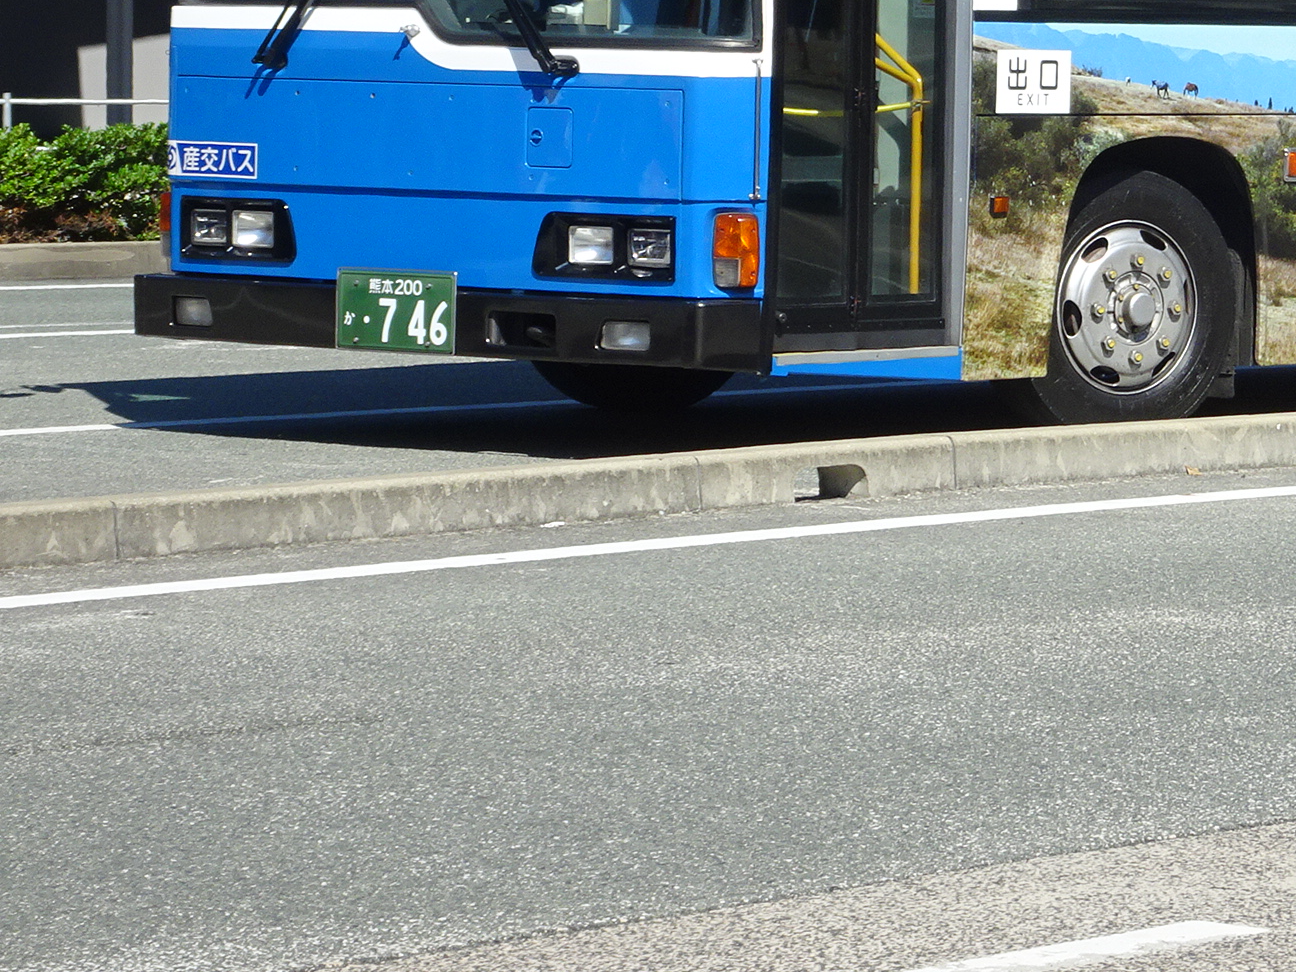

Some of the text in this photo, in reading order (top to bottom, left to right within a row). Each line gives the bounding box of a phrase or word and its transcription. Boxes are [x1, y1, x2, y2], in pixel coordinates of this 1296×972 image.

[1008, 56, 1059, 90] 出口
[1018, 93, 1049, 106] EXIT
[182, 146, 255, 174] 産交バス
